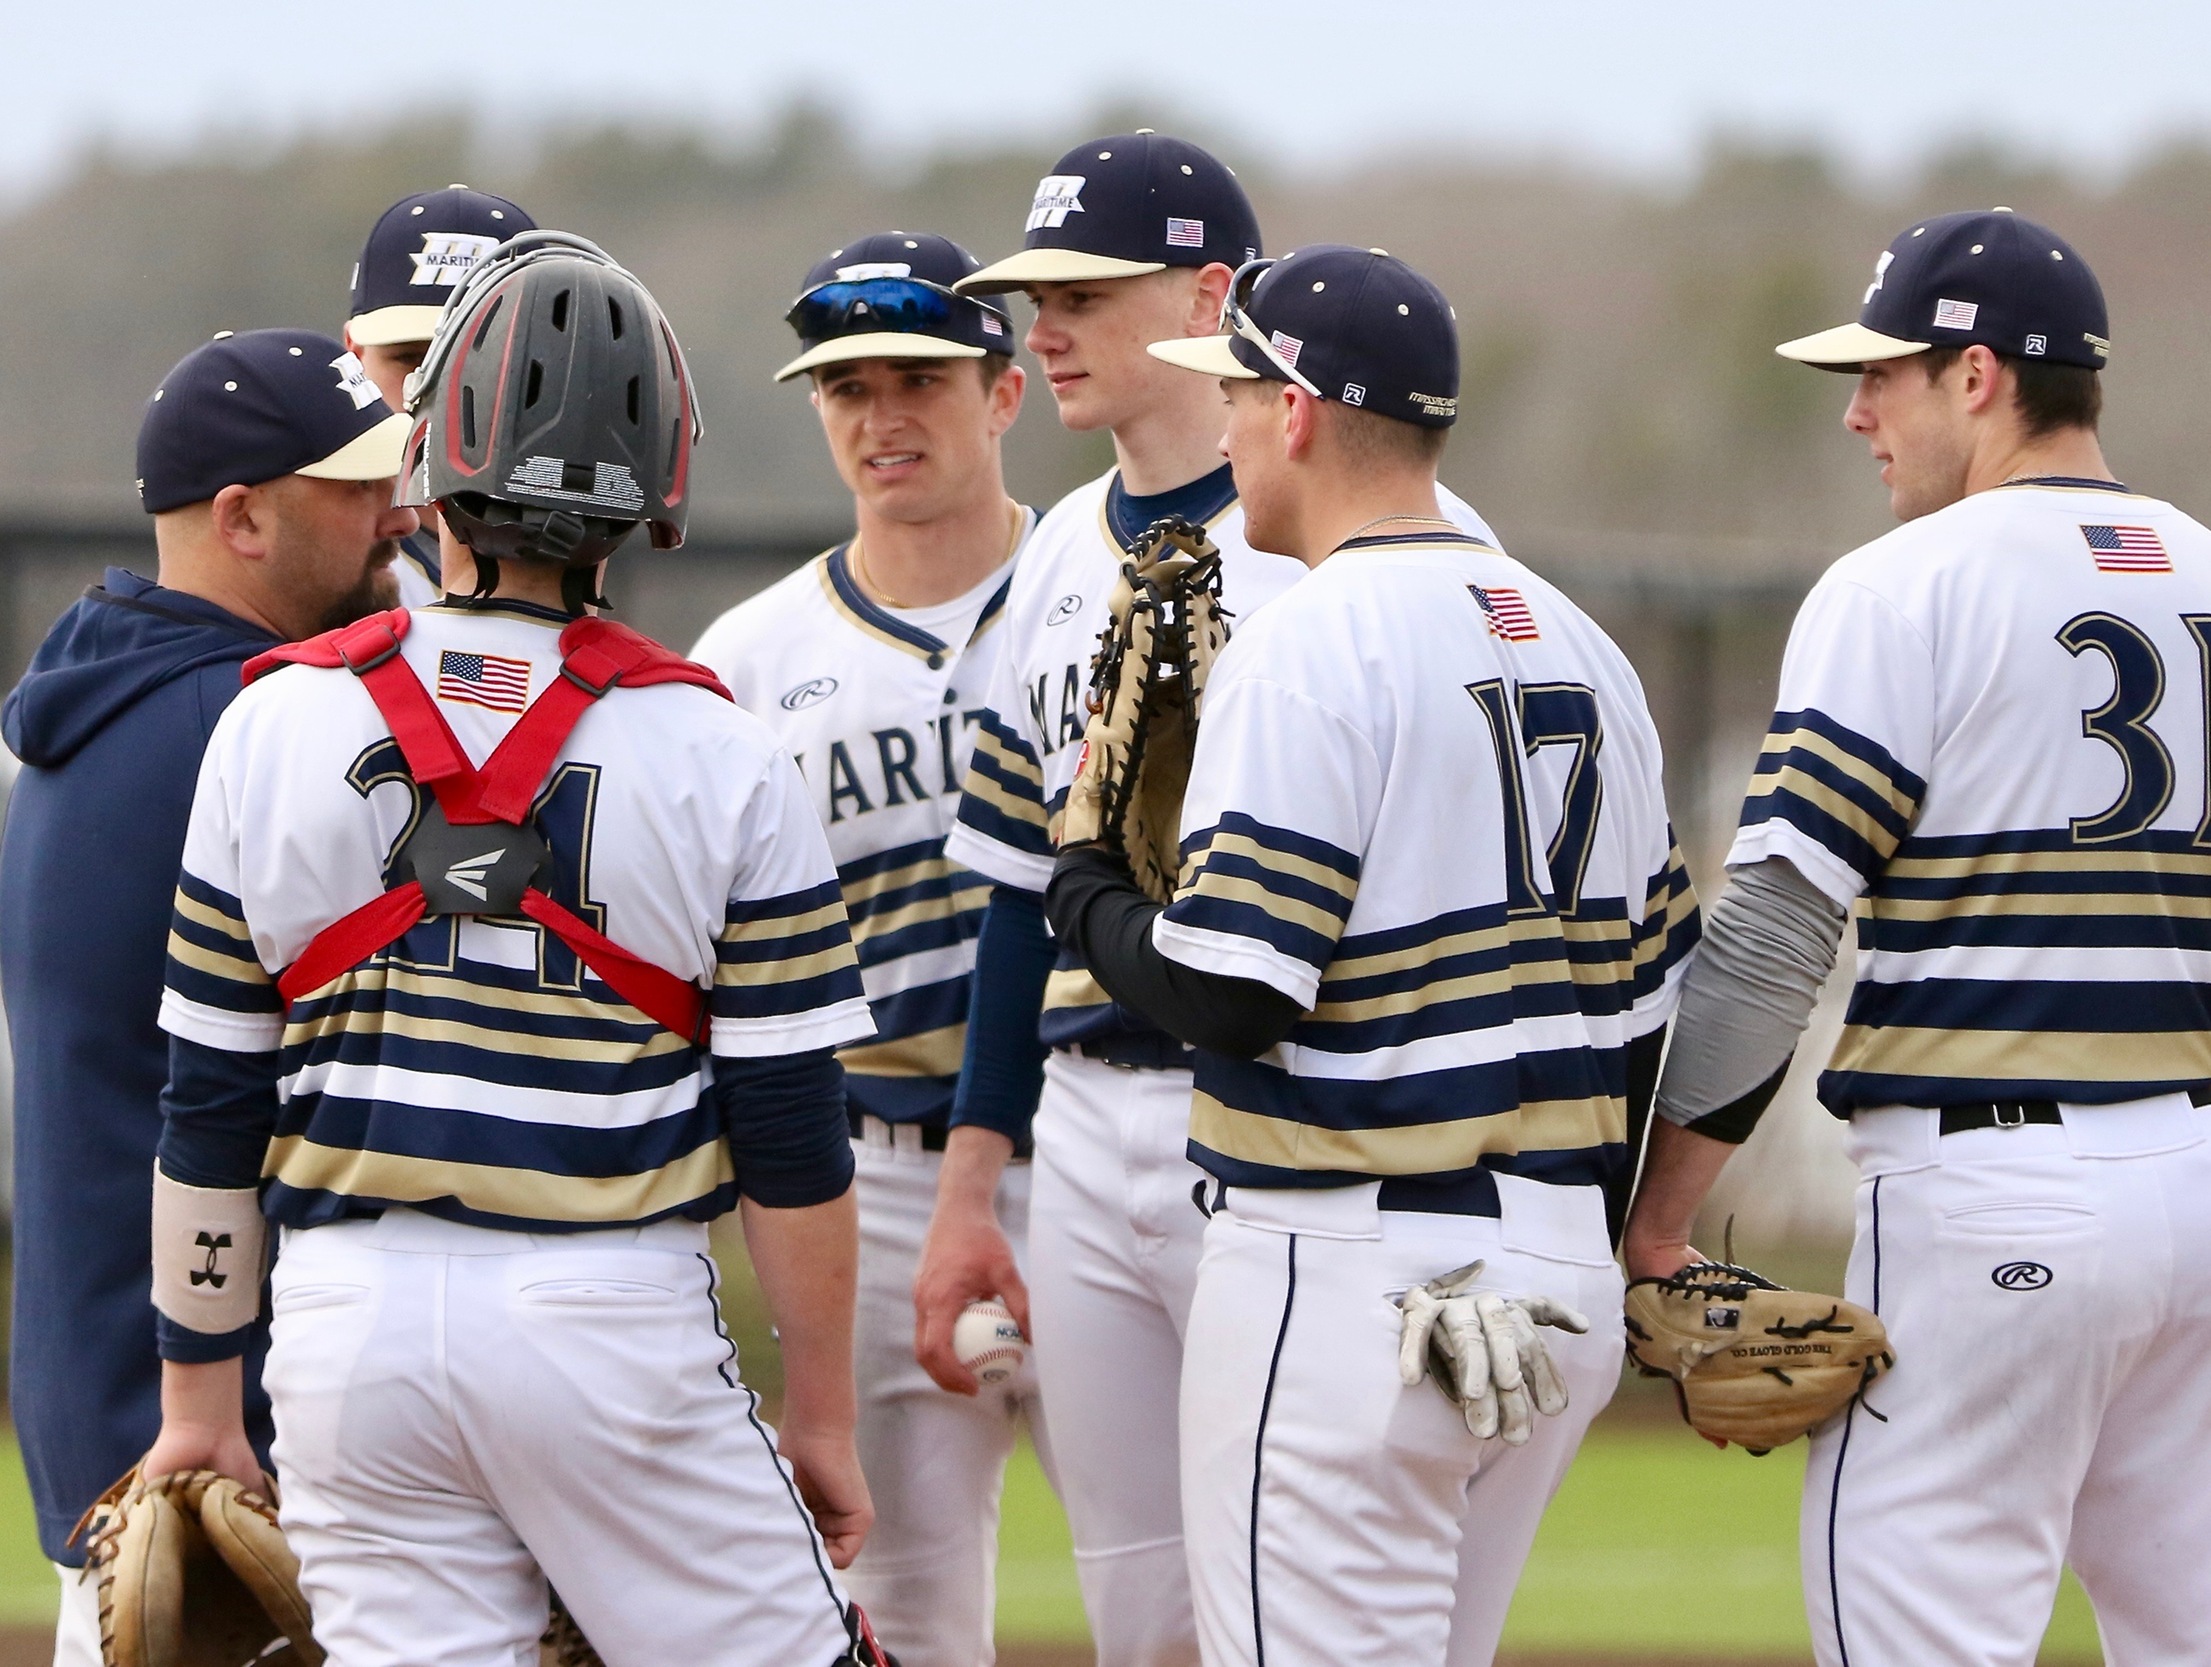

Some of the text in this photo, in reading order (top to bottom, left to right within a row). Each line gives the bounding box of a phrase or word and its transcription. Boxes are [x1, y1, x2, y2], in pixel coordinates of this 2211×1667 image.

[1463, 676, 1604, 918] 17
[344, 736, 608, 992] 24
[1749, 1345, 1782, 1357] GLOVE
[1784, 1344, 1812, 1355] GOLD
